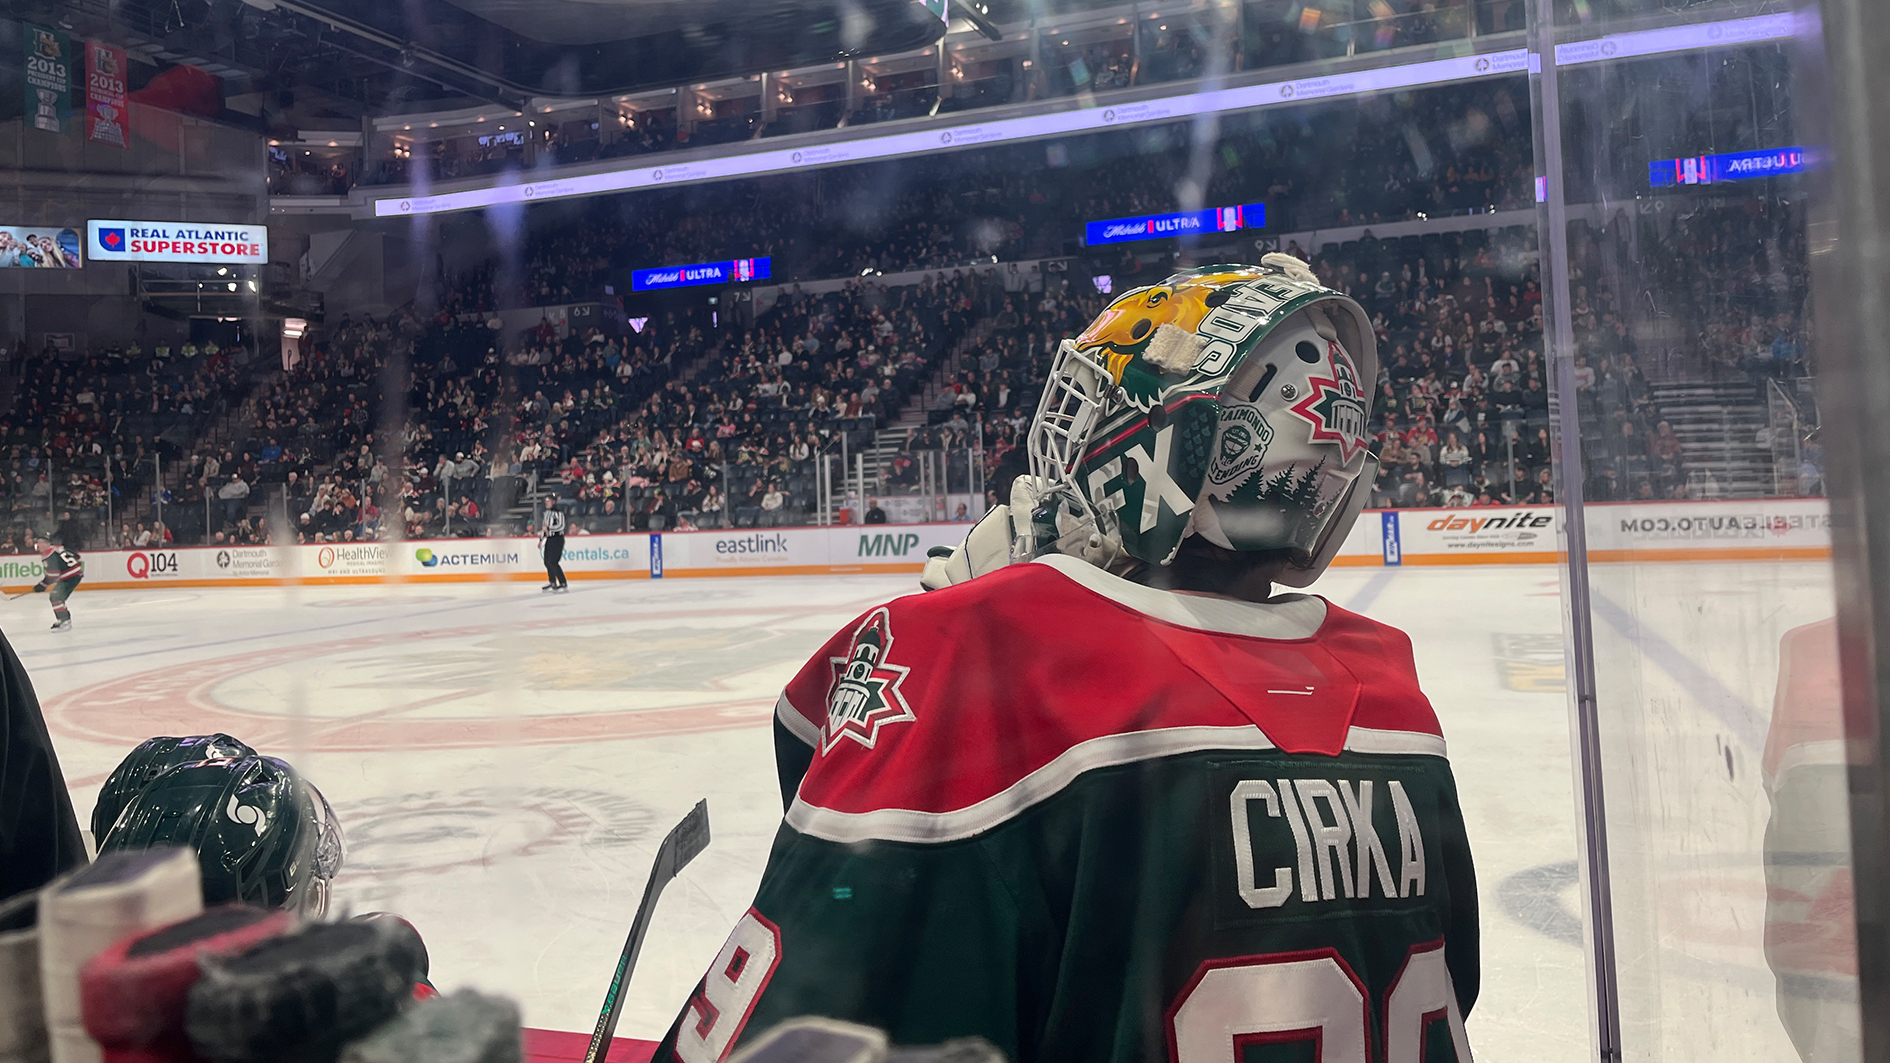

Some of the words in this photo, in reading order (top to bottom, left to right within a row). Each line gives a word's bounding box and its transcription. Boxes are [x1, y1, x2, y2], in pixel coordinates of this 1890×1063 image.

[1492, 52, 1527, 62] Dartmout
[27, 56, 67, 78] 2013
[27, 76, 67, 93] CHAMPIONS
[90, 73, 124, 93] 2013
[1155, 216, 1201, 232] ULTRA
[130, 228, 170, 239] REAL
[176, 229, 249, 241] ATLANTIC
[131, 239, 260, 256] SUPERSTORE
[686, 267, 722, 281] ULTRA
[1189, 272, 1312, 377] EADS
[1427, 512, 1553, 534] daynite
[716, 533, 788, 554] eastlink
[857, 533, 920, 557] MNP
[232, 549, 267, 559] Dartmouth
[440, 553, 519, 566] ACTEMIUM
[562, 547, 630, 561] Rentals.ca
[0, 561, 46, 579] ffleb
[127, 552, 179, 579] Q104
[232, 559, 262, 569] Memorial
[1229, 778, 1427, 910] CIRKA
